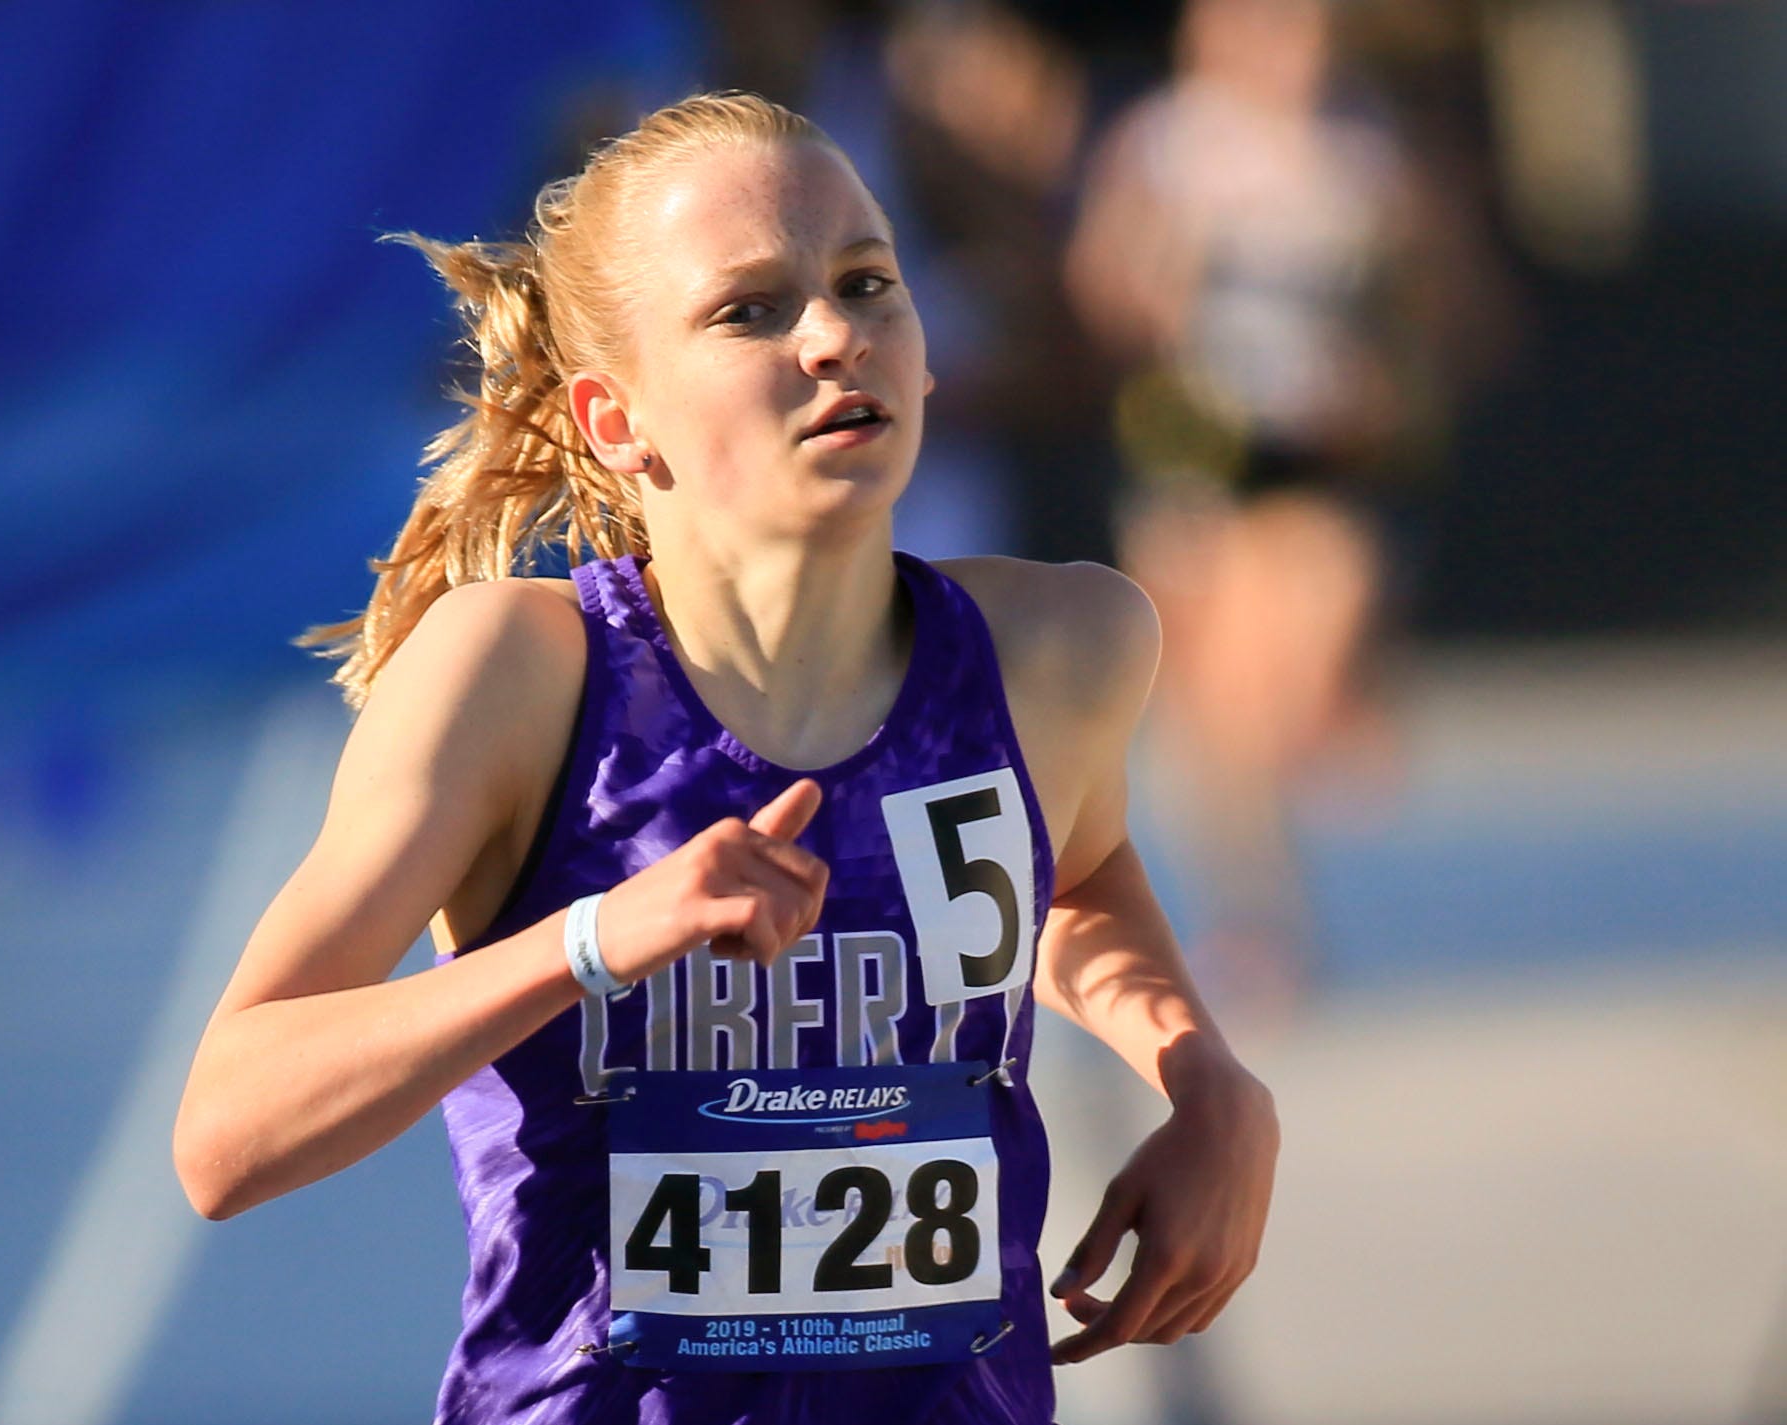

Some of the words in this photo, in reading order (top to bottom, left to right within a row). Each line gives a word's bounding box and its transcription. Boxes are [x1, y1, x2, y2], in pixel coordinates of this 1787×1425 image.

[925, 787, 1019, 987] 5
[724, 1078, 826, 1112] Drake
[829, 1086, 907, 1109] RELAYS
[625, 1159, 980, 1294] 4128
[706, 1320, 756, 1338] 2019
[778, 1318, 834, 1336] 110th
[840, 1313, 905, 1336] Annual
[677, 1338, 776, 1356] America's
[782, 1336, 859, 1354] Athletic
[865, 1330, 931, 1352] Classic
